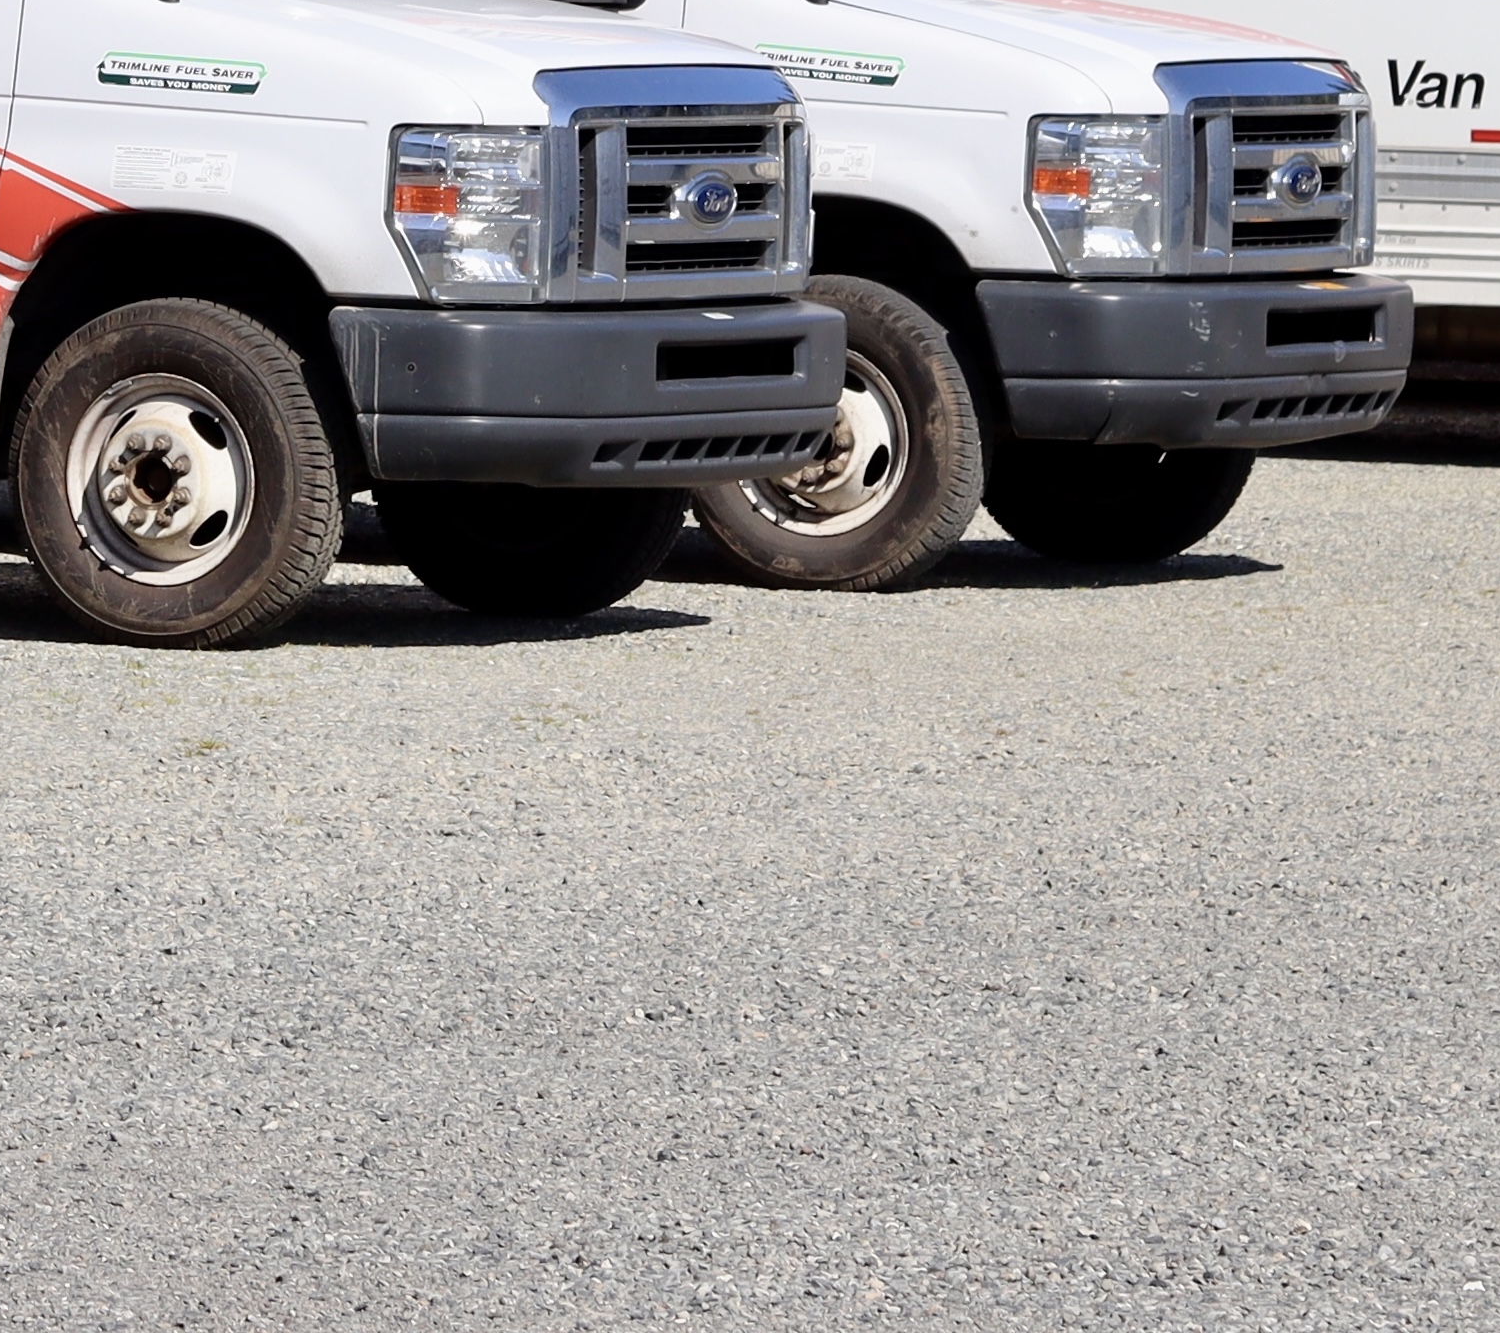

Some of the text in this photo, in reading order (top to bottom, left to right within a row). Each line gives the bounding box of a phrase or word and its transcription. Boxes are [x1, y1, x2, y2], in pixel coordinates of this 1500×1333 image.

[110, 60, 171, 74] TRIMLINE
[175, 65, 207, 77] FUEL
[820, 58, 850, 69] FUEL
[129, 76, 232, 93] SAVES YOU MONEY
[812, 71, 834, 80] YOU
[834, 72, 872, 84] MONEY
[1387, 59, 1485, 110] Van
